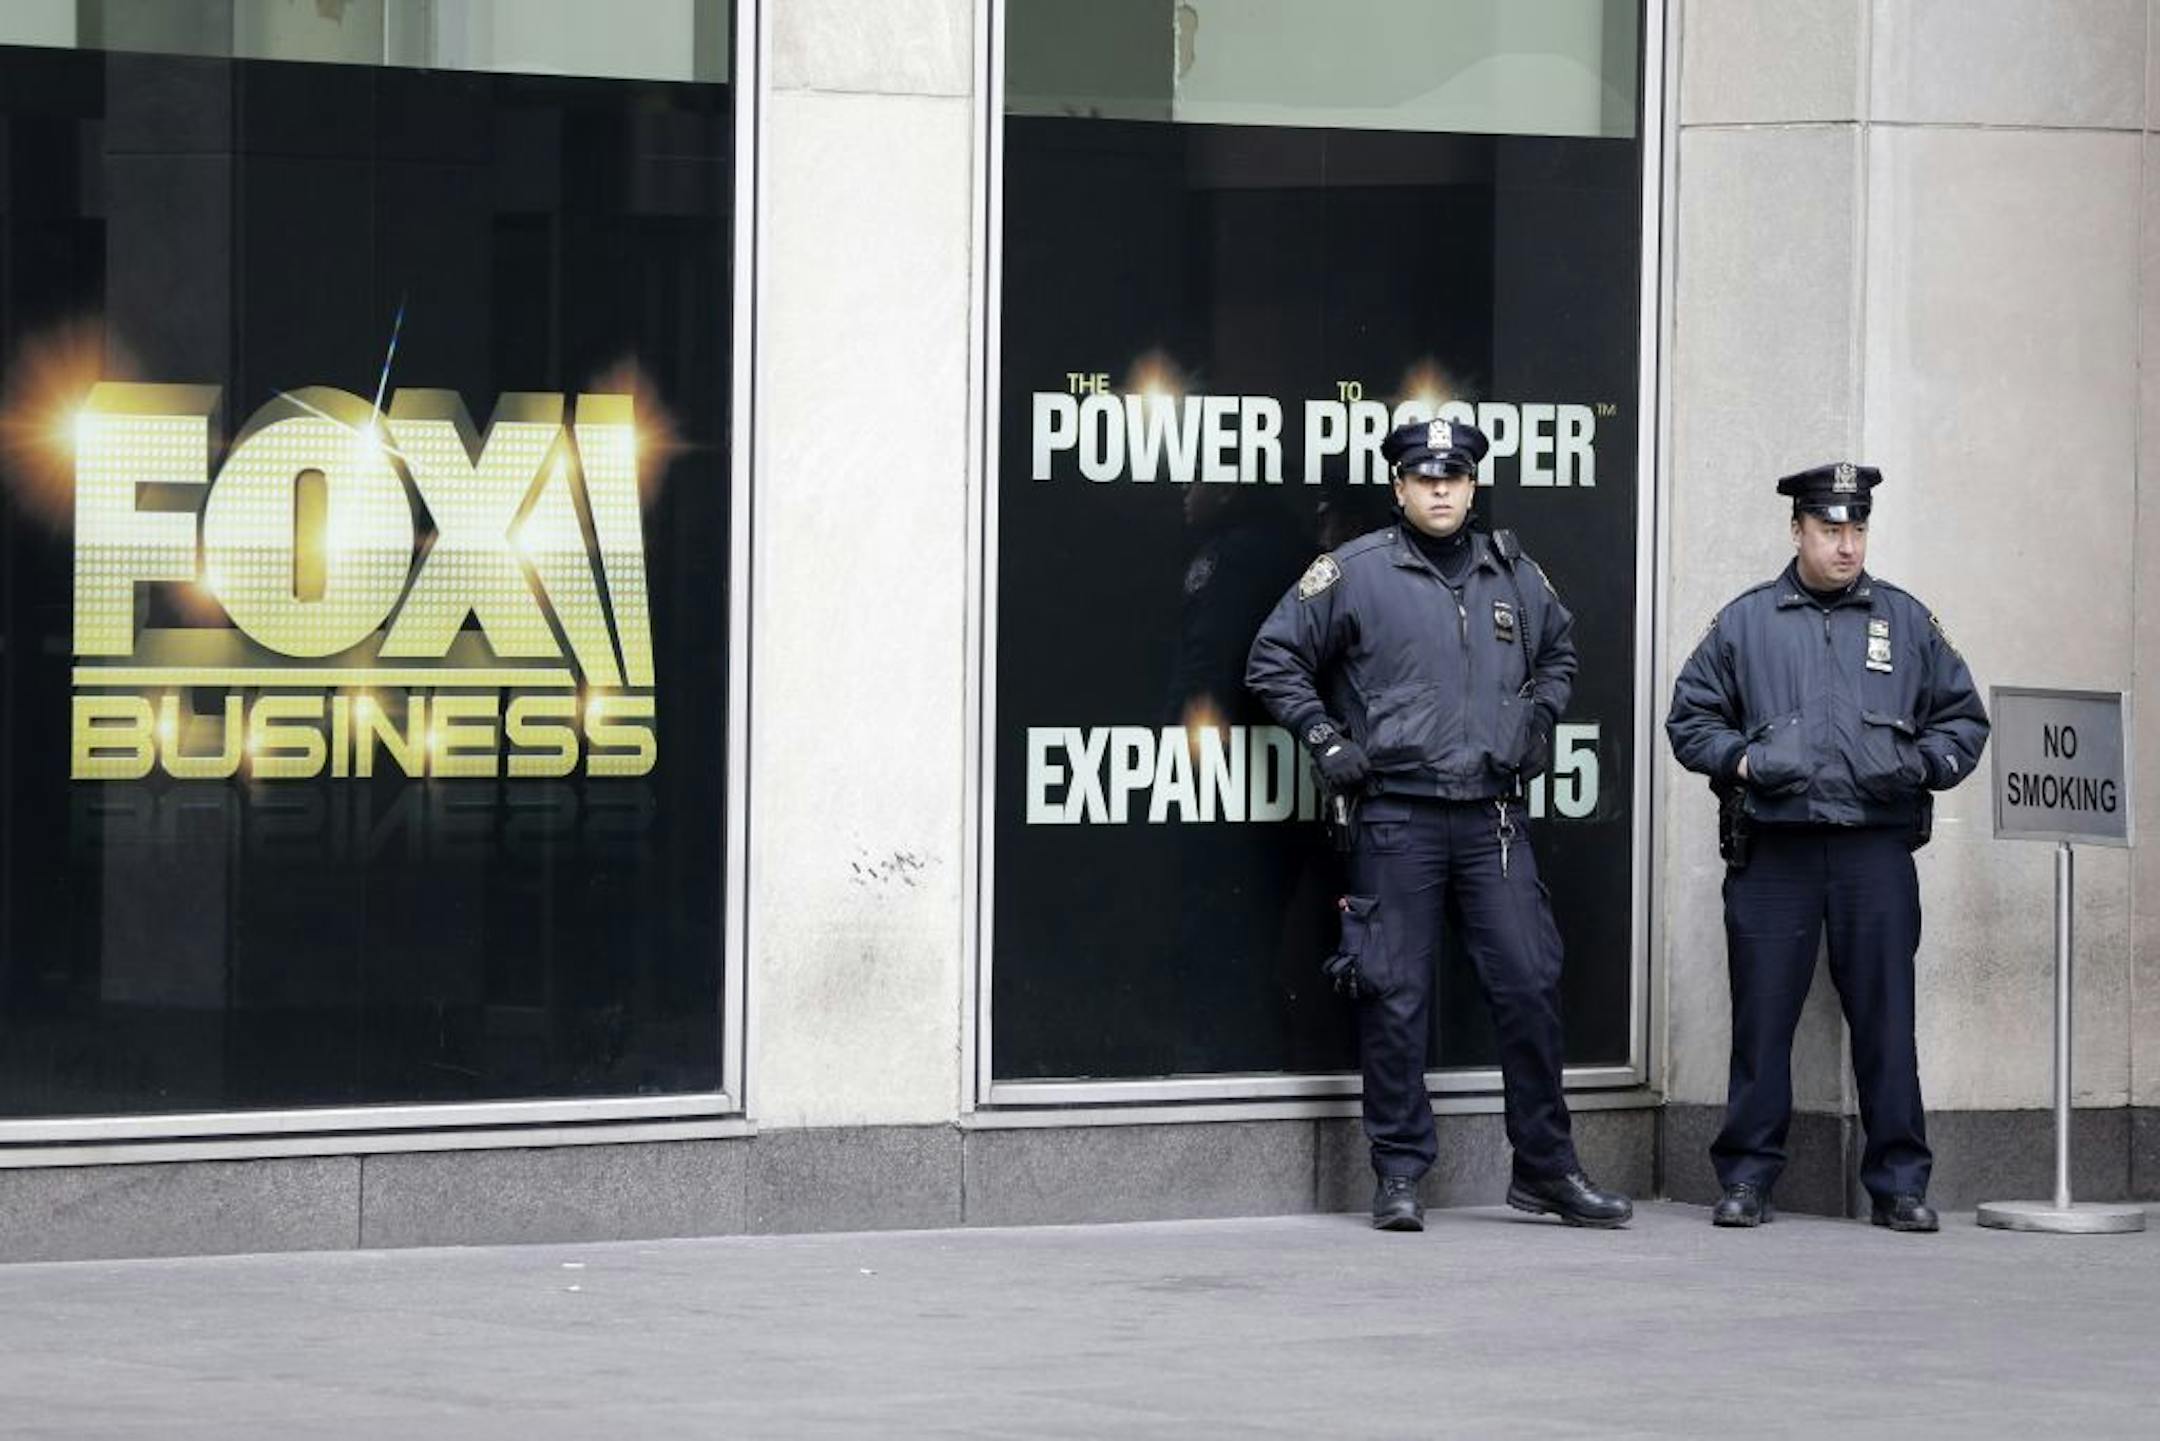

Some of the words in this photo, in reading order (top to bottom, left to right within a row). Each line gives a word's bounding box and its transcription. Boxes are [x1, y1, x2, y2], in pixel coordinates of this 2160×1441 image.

[1066, 372, 1110, 394] THE
[1337, 381, 1361, 402] TO
[1032, 391, 1283, 484] POWER
[1305, 400, 1596, 487] PRPER
[73, 384, 655, 686] FOX
[70, 694, 657, 779] BUSINESS
[1026, 726, 1326, 823] EXPANDI
[2043, 725, 2077, 759] NO
[2007, 772, 2117, 813] SMOKING
